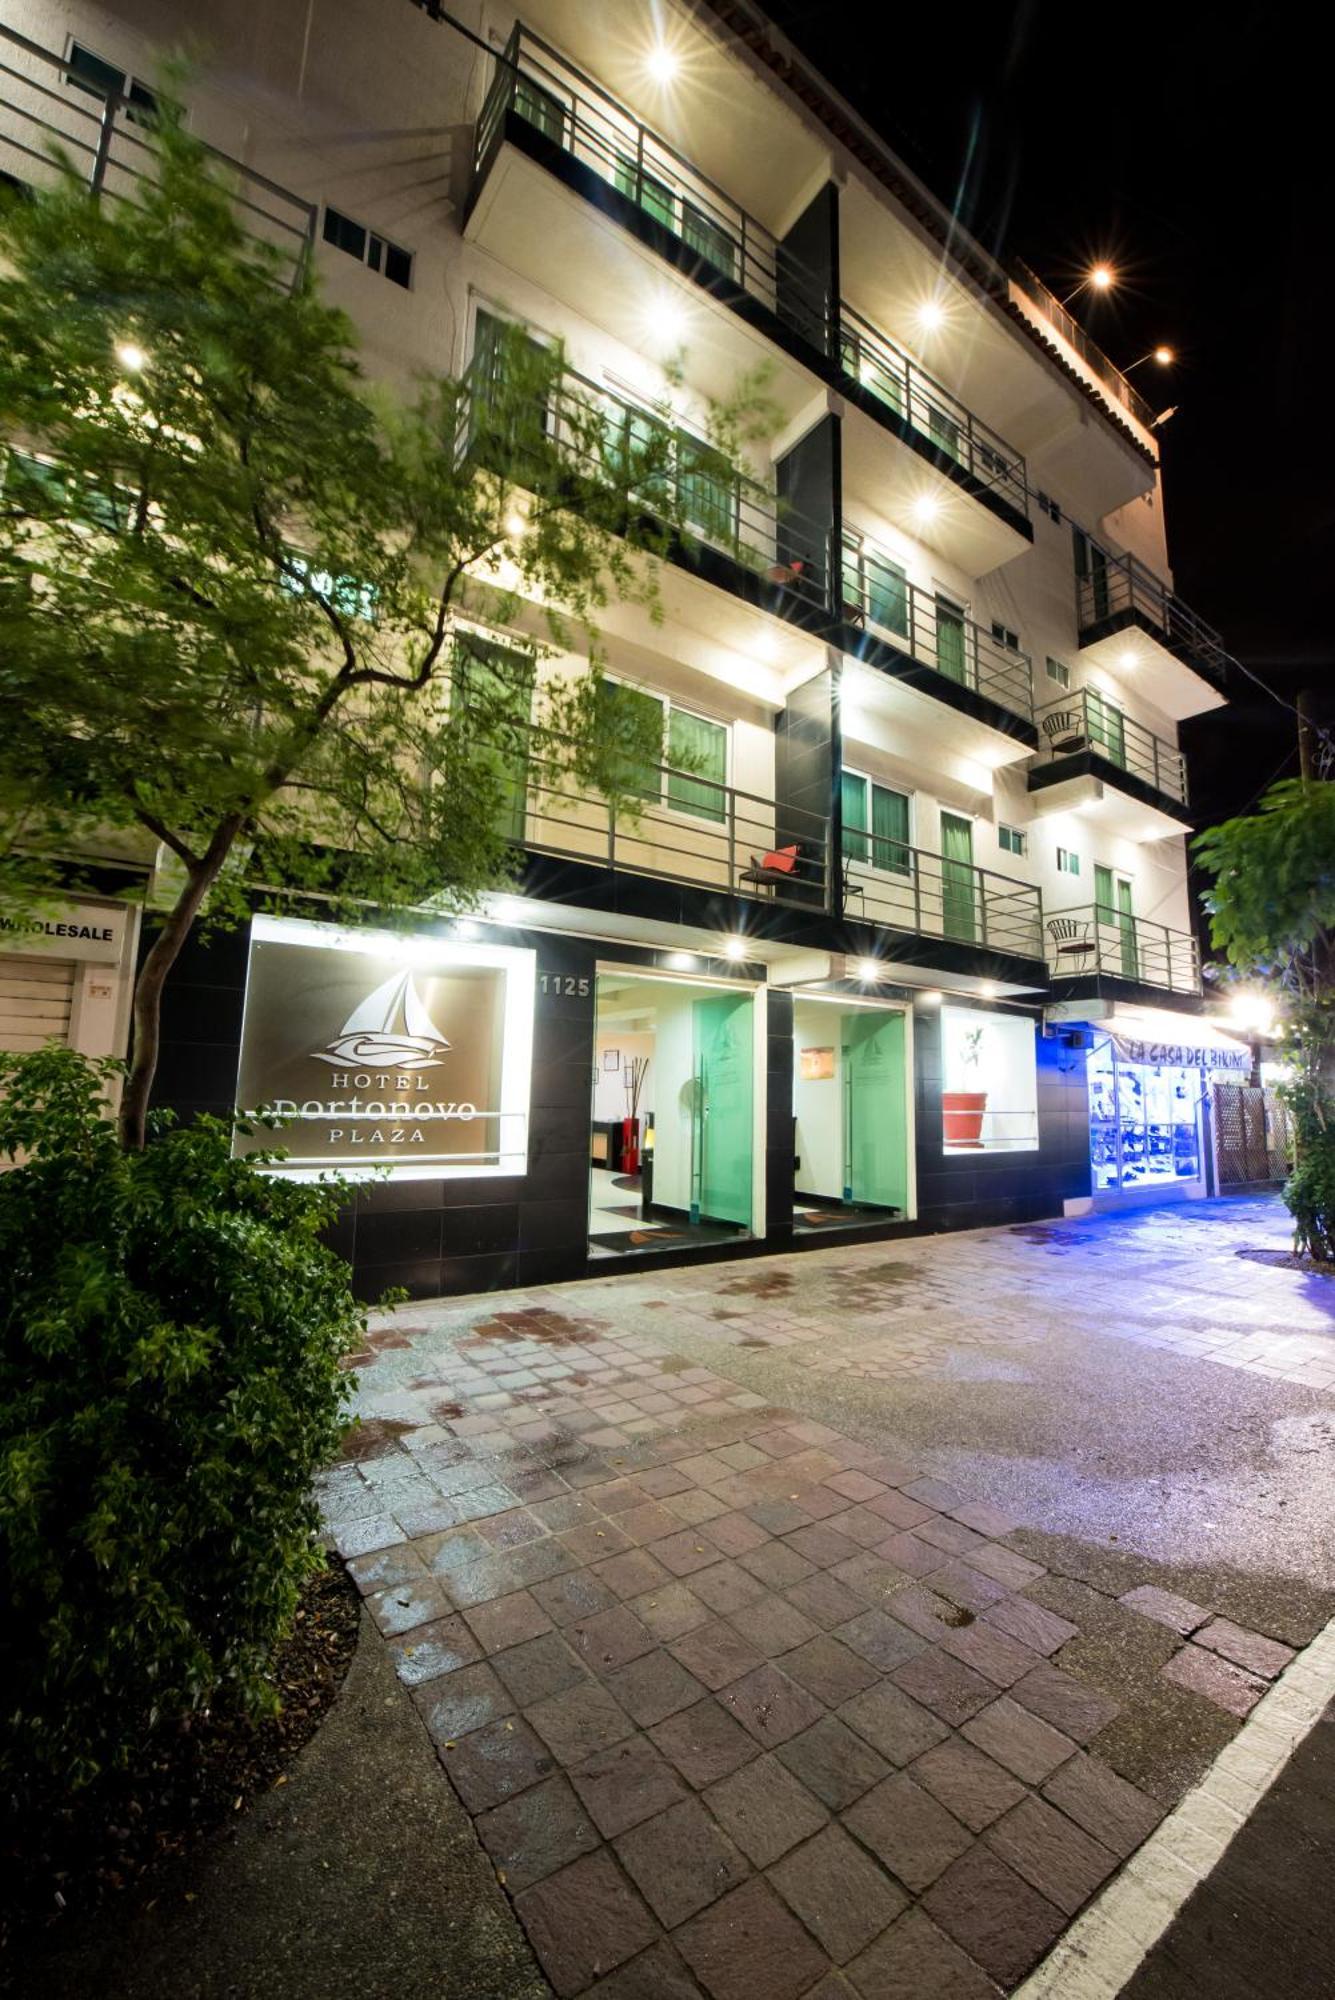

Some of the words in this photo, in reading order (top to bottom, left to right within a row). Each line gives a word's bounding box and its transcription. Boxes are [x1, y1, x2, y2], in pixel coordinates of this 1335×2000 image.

[540, 975, 590, 997] 1125
[1129, 1041, 1145, 1061] LA
[1149, 1044, 1183, 1064] CASA
[1186, 1047, 1208, 1066] DEL
[1210, 1049, 1243, 1068] BIKINI
[331, 1073, 429, 1090] HOTEL
[329, 1129, 425, 1143] PLAZA
